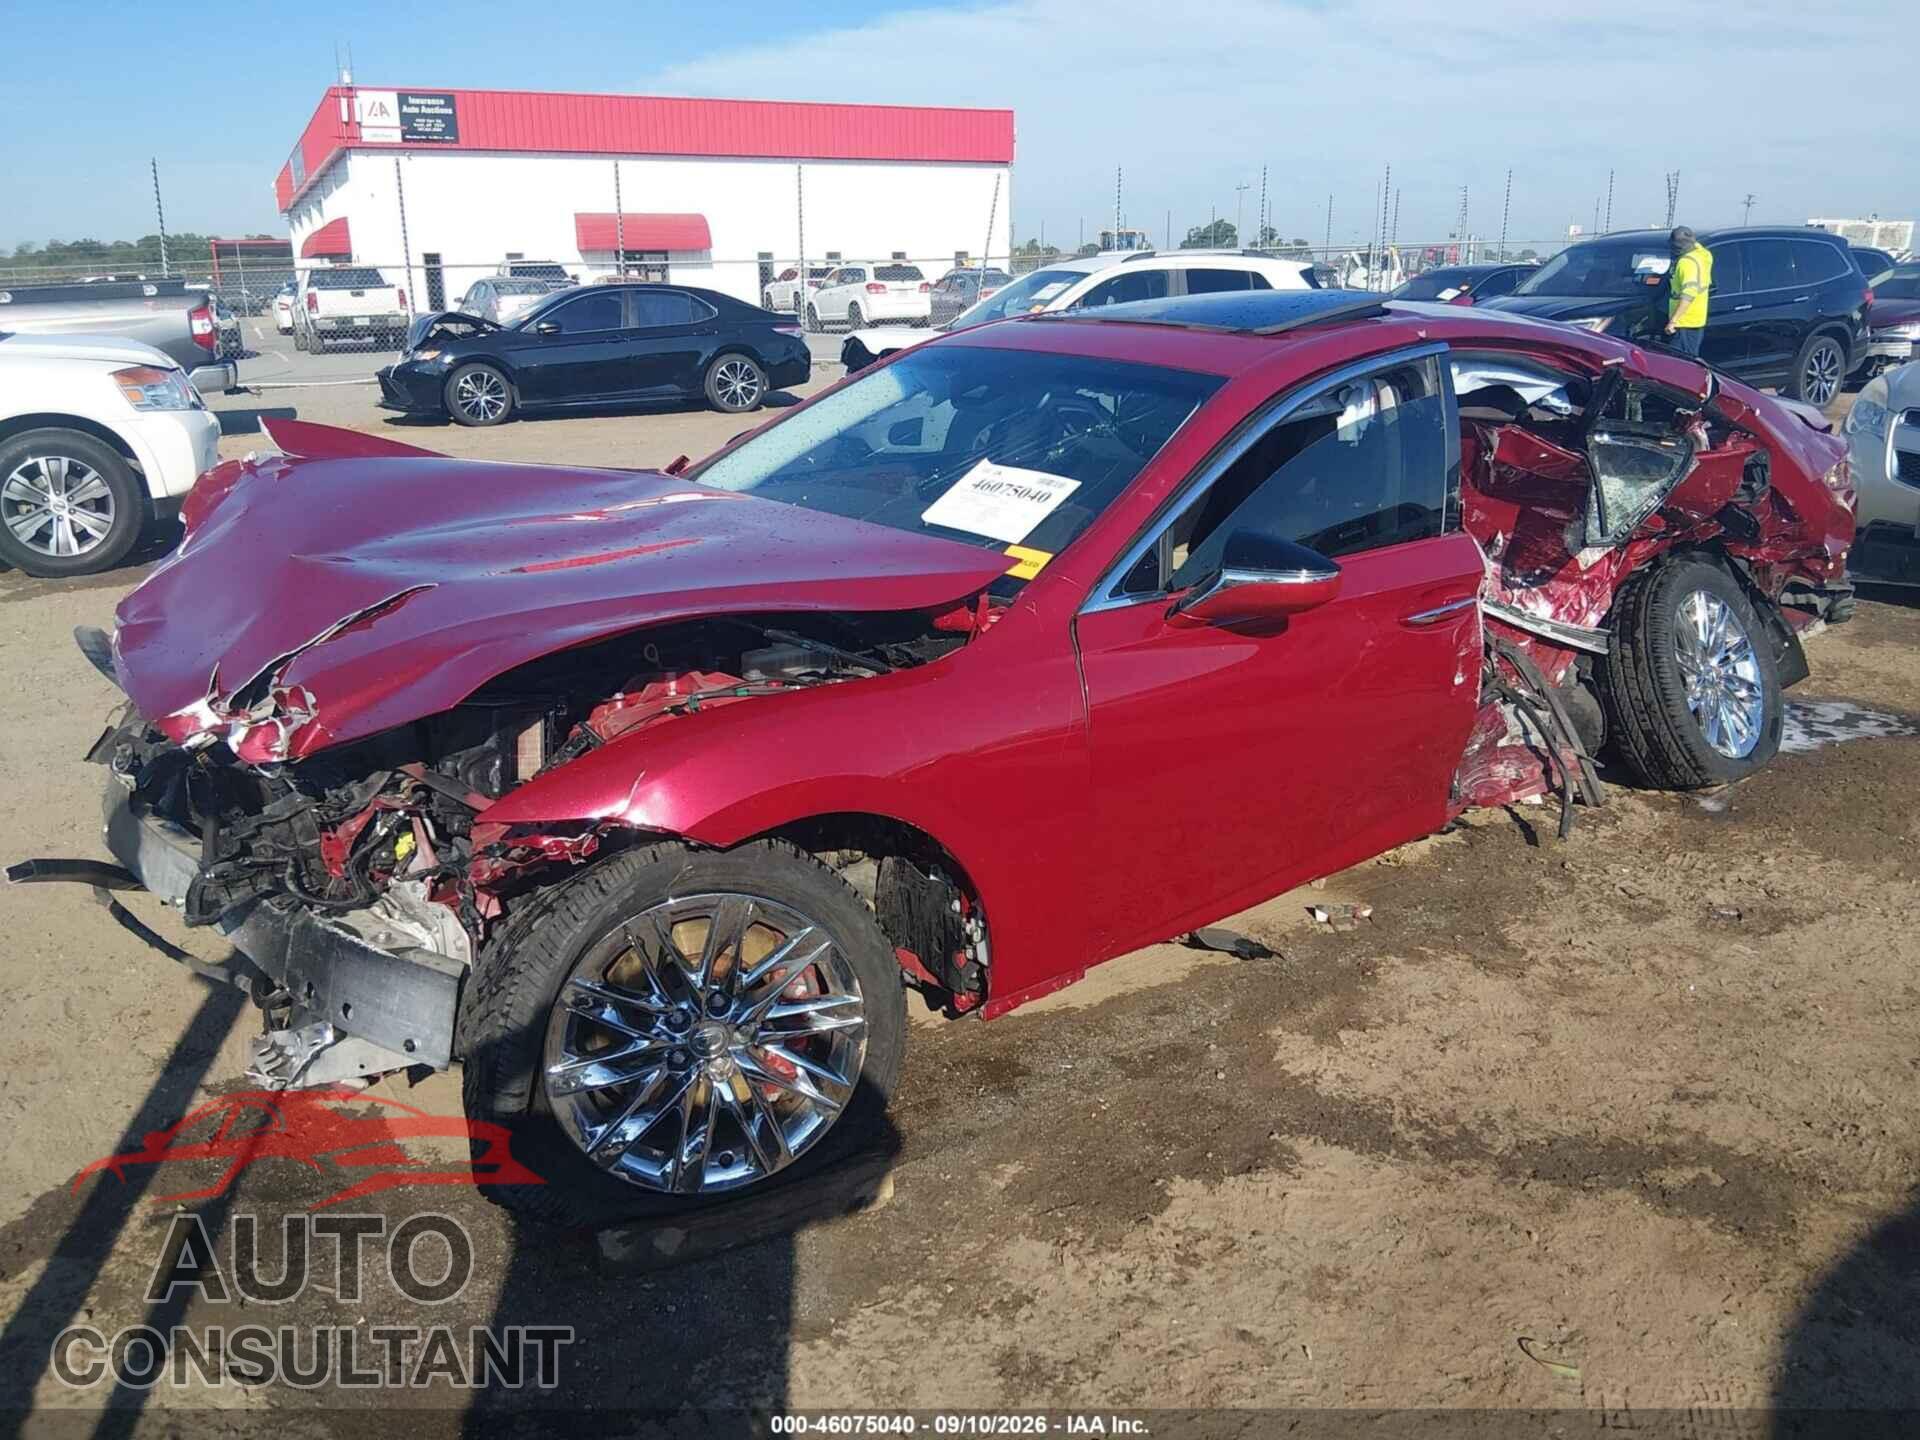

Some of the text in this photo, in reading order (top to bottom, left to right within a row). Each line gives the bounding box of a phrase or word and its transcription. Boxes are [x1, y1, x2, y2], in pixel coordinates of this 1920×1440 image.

[402, 105, 453, 114] Auto Auctions
[971, 478, 1053, 504] 46075040
